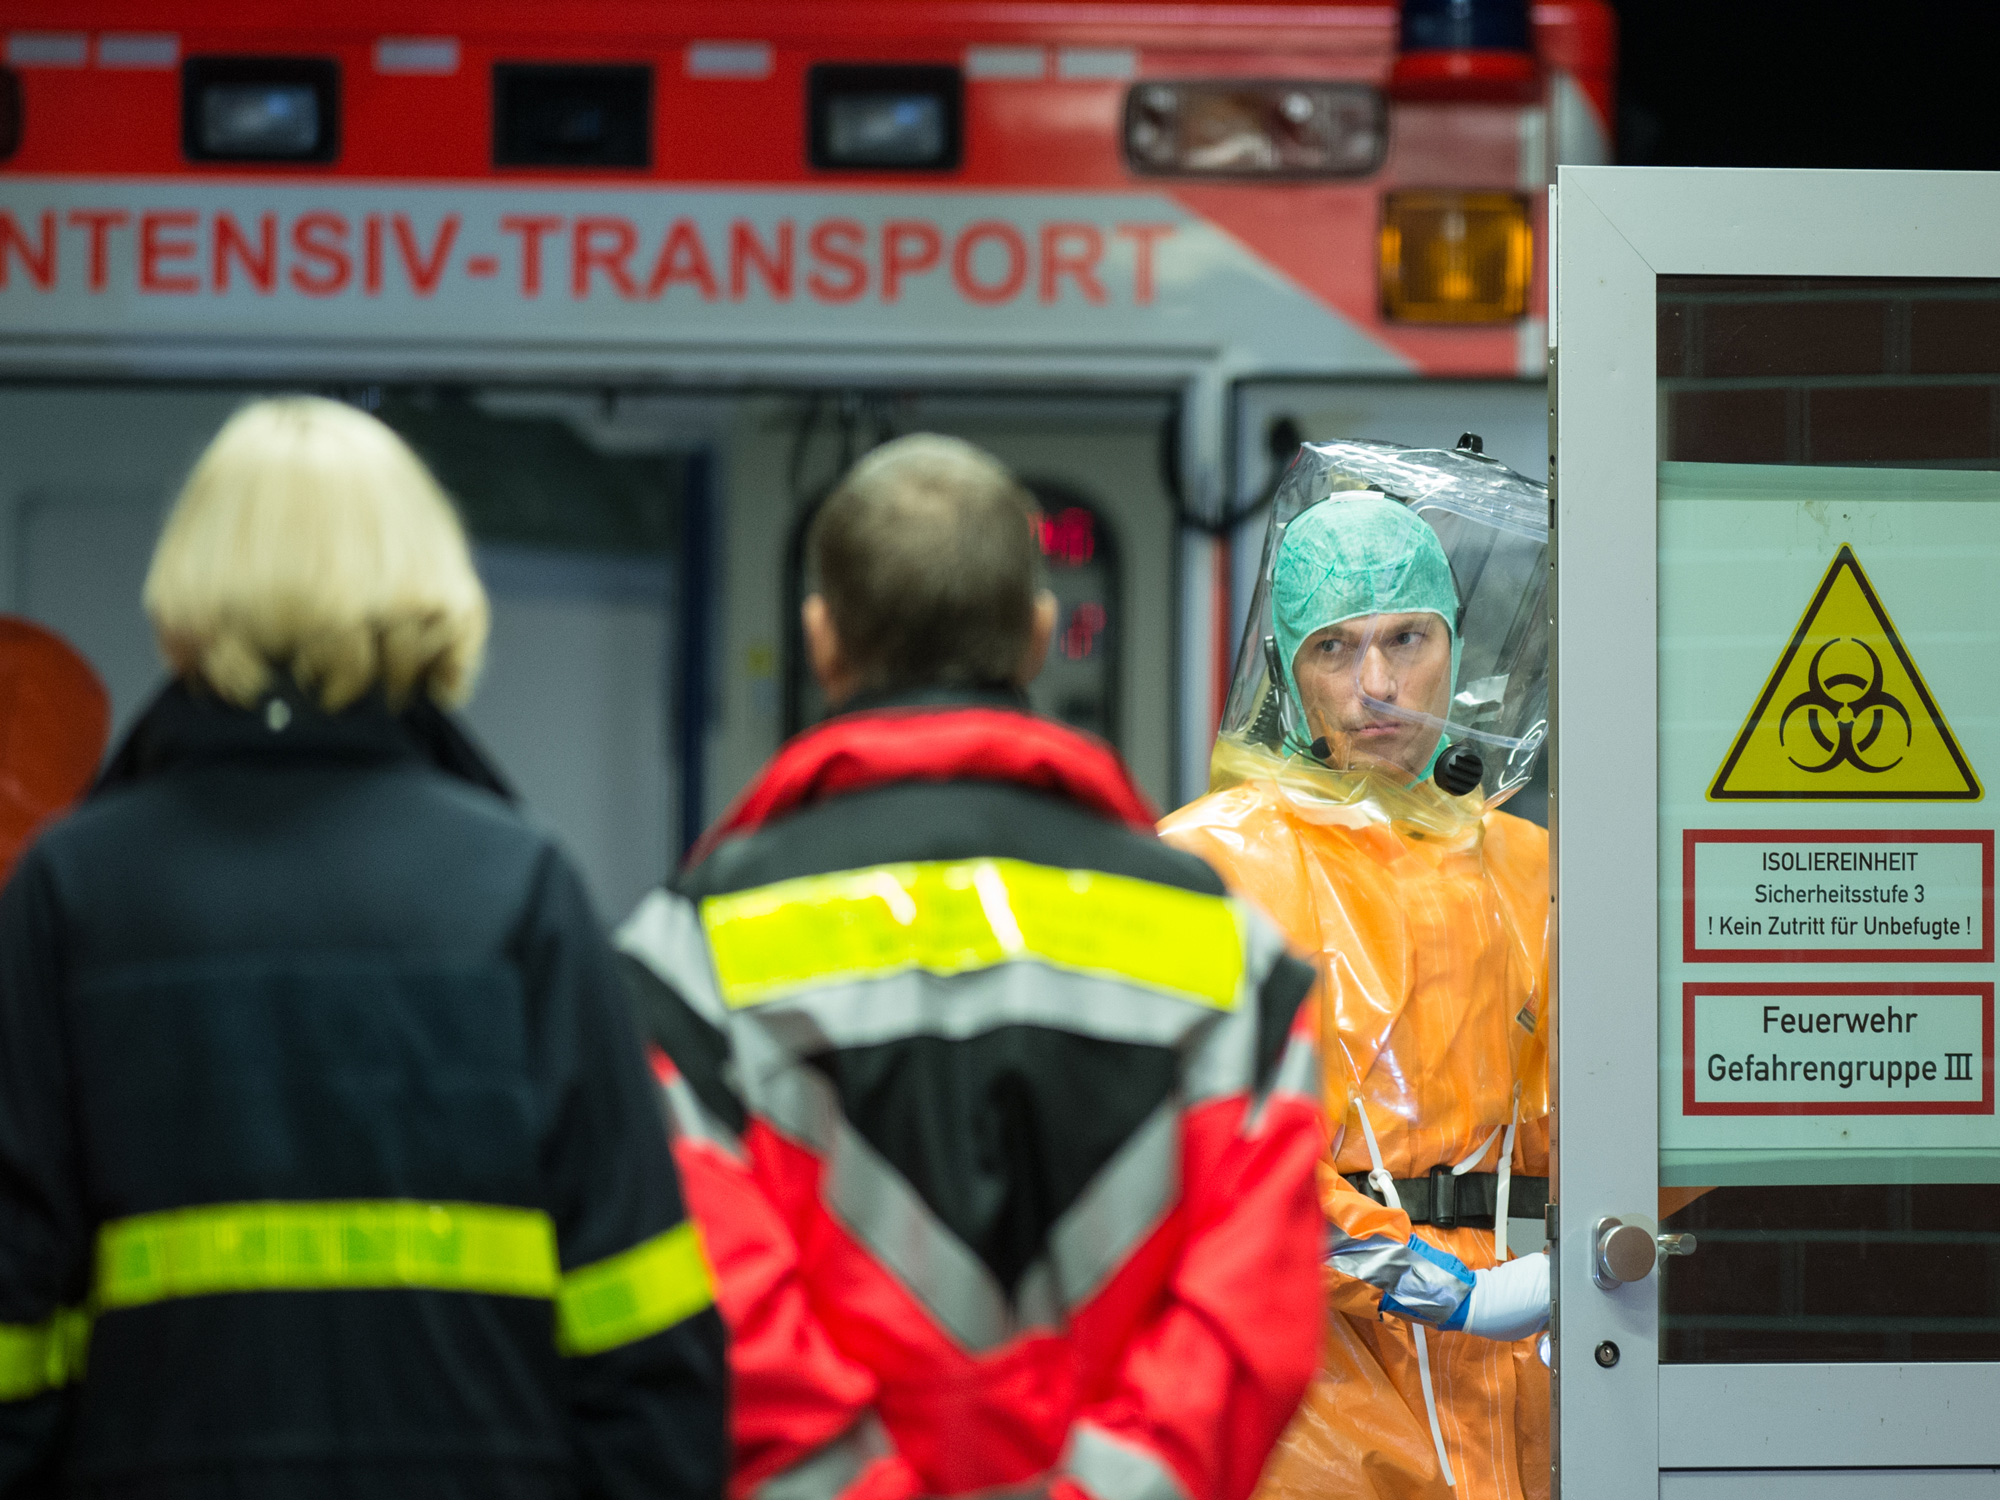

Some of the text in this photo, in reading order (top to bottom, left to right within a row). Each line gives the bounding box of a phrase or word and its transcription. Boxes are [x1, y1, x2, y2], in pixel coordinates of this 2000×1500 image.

[0, 207, 1177, 307] NTENSIV-TRANSPORT
[1762, 851, 1919, 871] ISOLIEREINHEIT
[1754, 883, 1925, 903] Sicherheitsstufe 3
[1719, 915, 1763, 936] Kein
[1767, 915, 1826, 936] Zutritt
[1830, 915, 1859, 936] für
[1864, 915, 1961, 941] Unbefugte
[1762, 1004, 1919, 1034] Feuerwehr
[1707, 1052, 1974, 1089] Gefahrengruppe III
